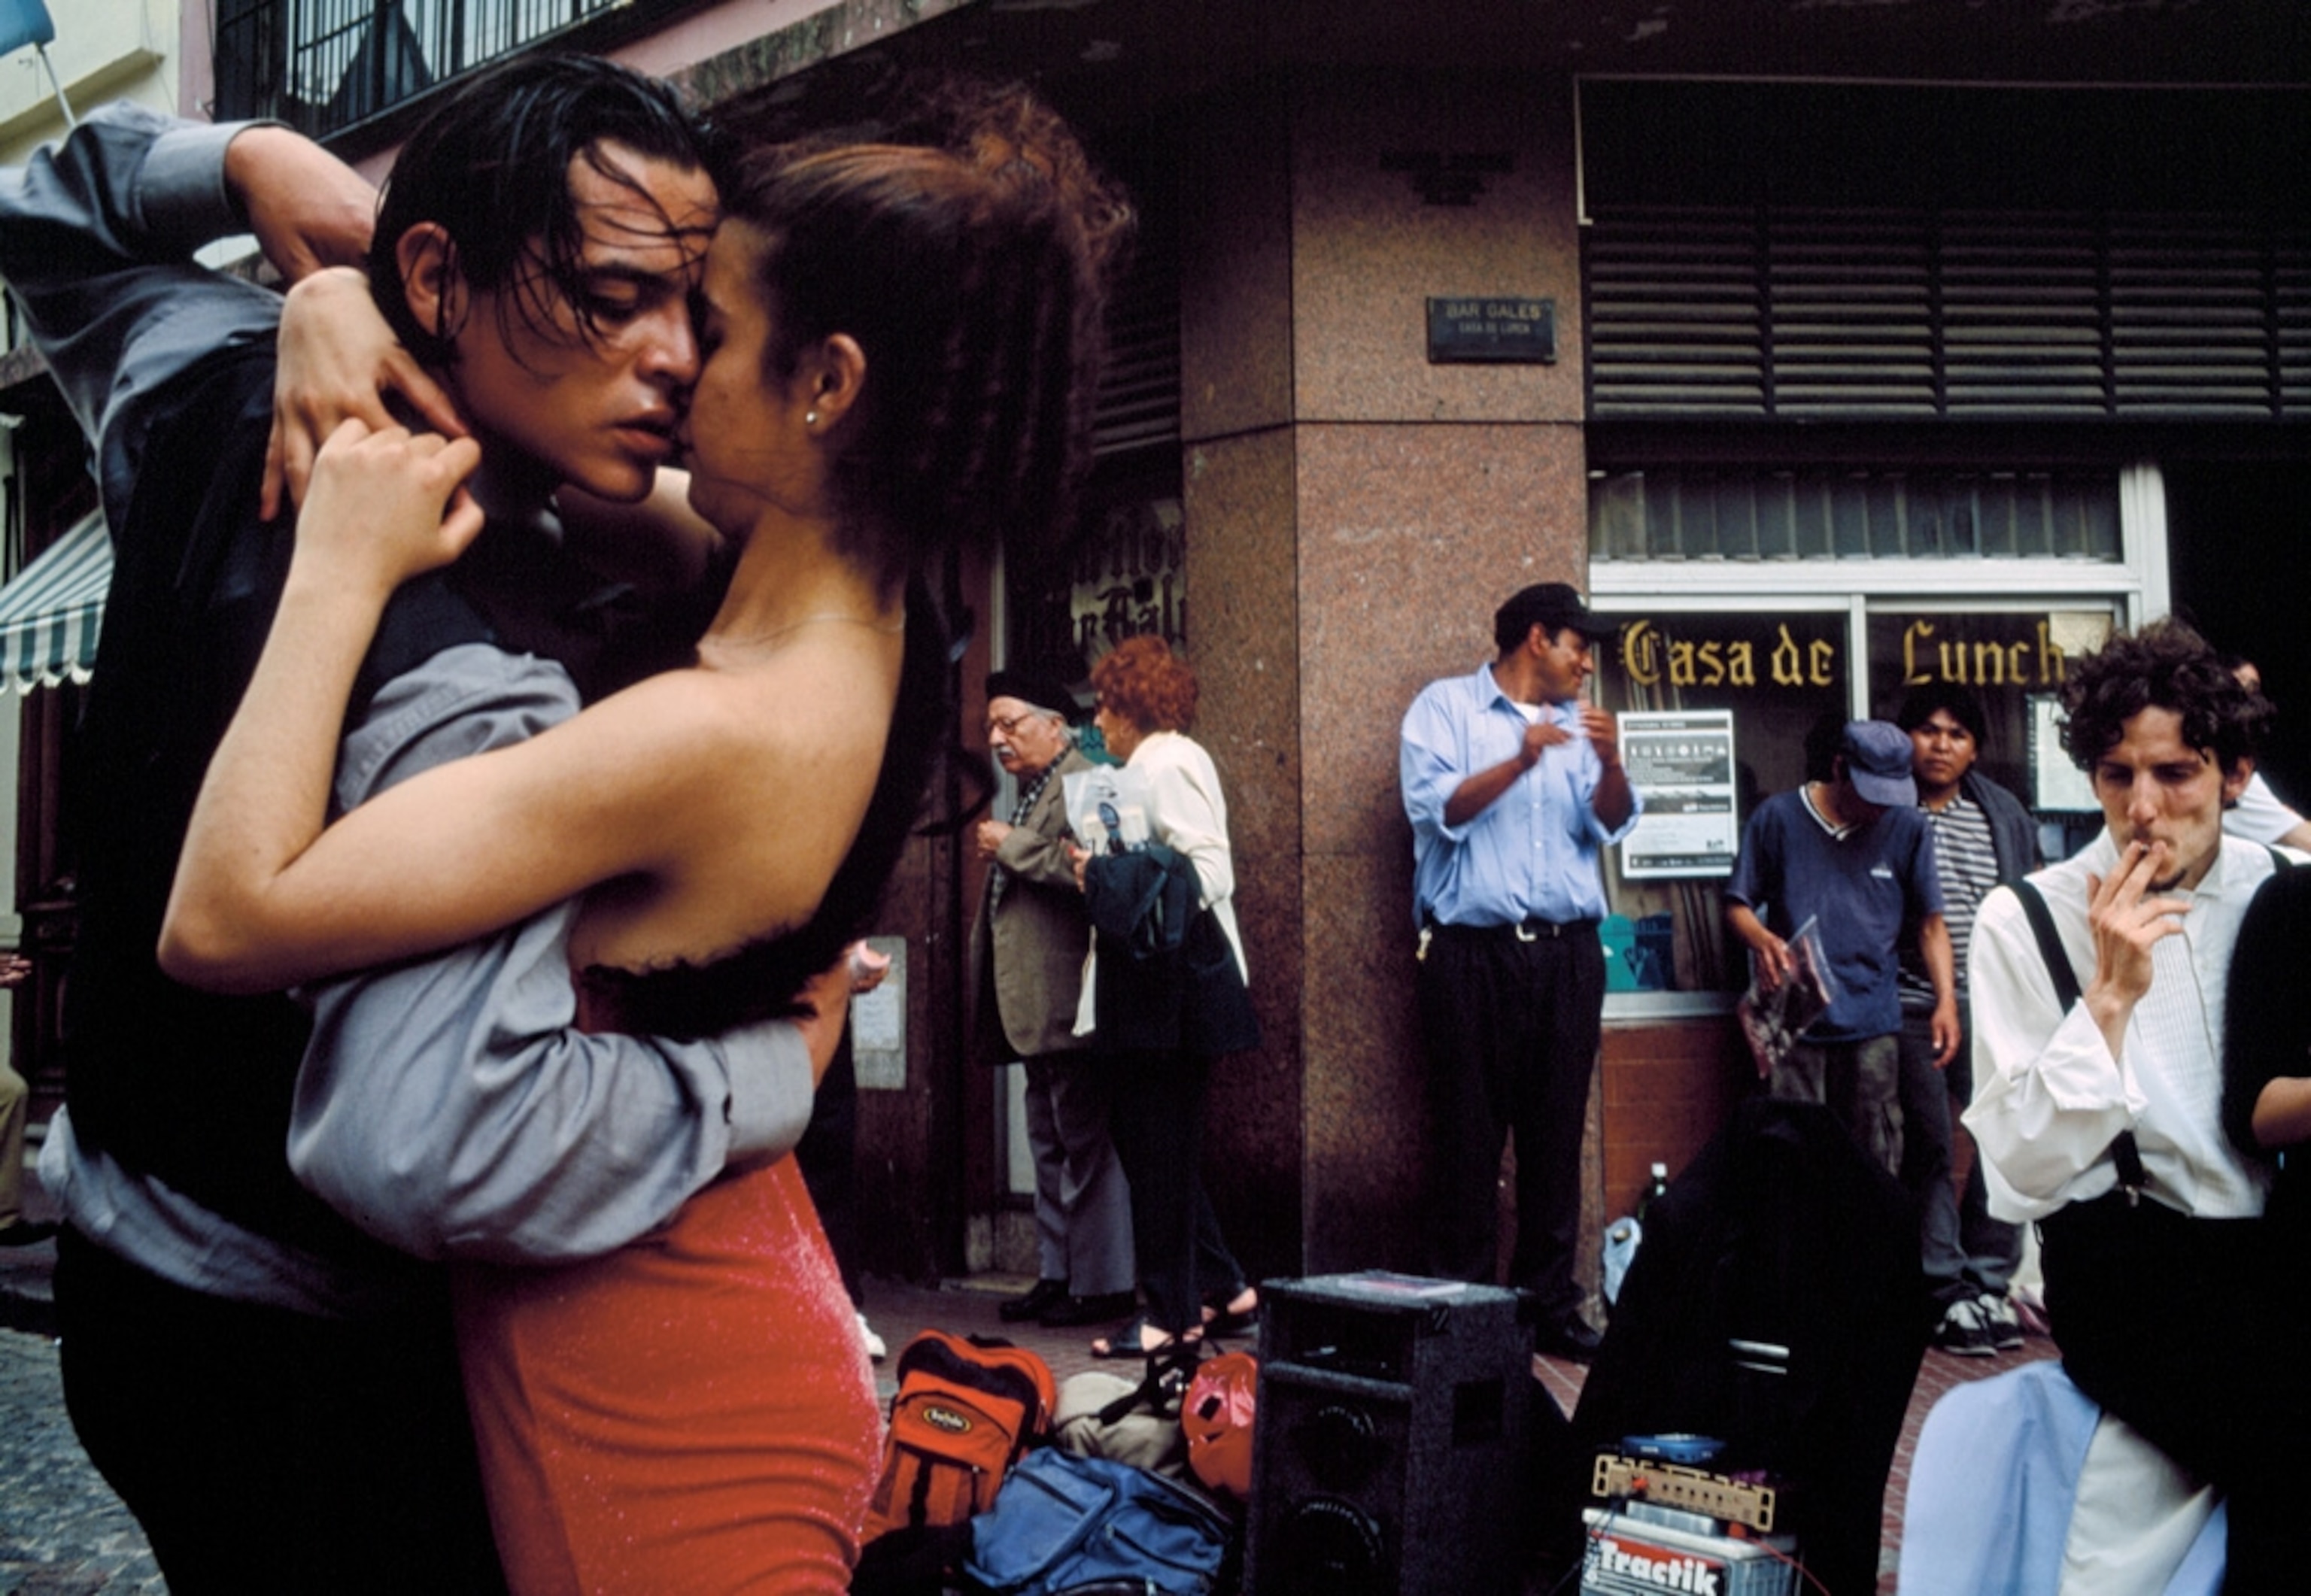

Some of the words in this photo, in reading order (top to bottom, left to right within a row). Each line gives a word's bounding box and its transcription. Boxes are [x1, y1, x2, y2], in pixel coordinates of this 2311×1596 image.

[1446, 302, 1480, 318] BAR
[1487, 302, 1541, 321] GALES
[1619, 620, 1757, 686] Casa
[1772, 622, 1834, 686] de
[1904, 619, 2065, 686] Lunch
[1598, 1538, 1720, 1596] Tractik
